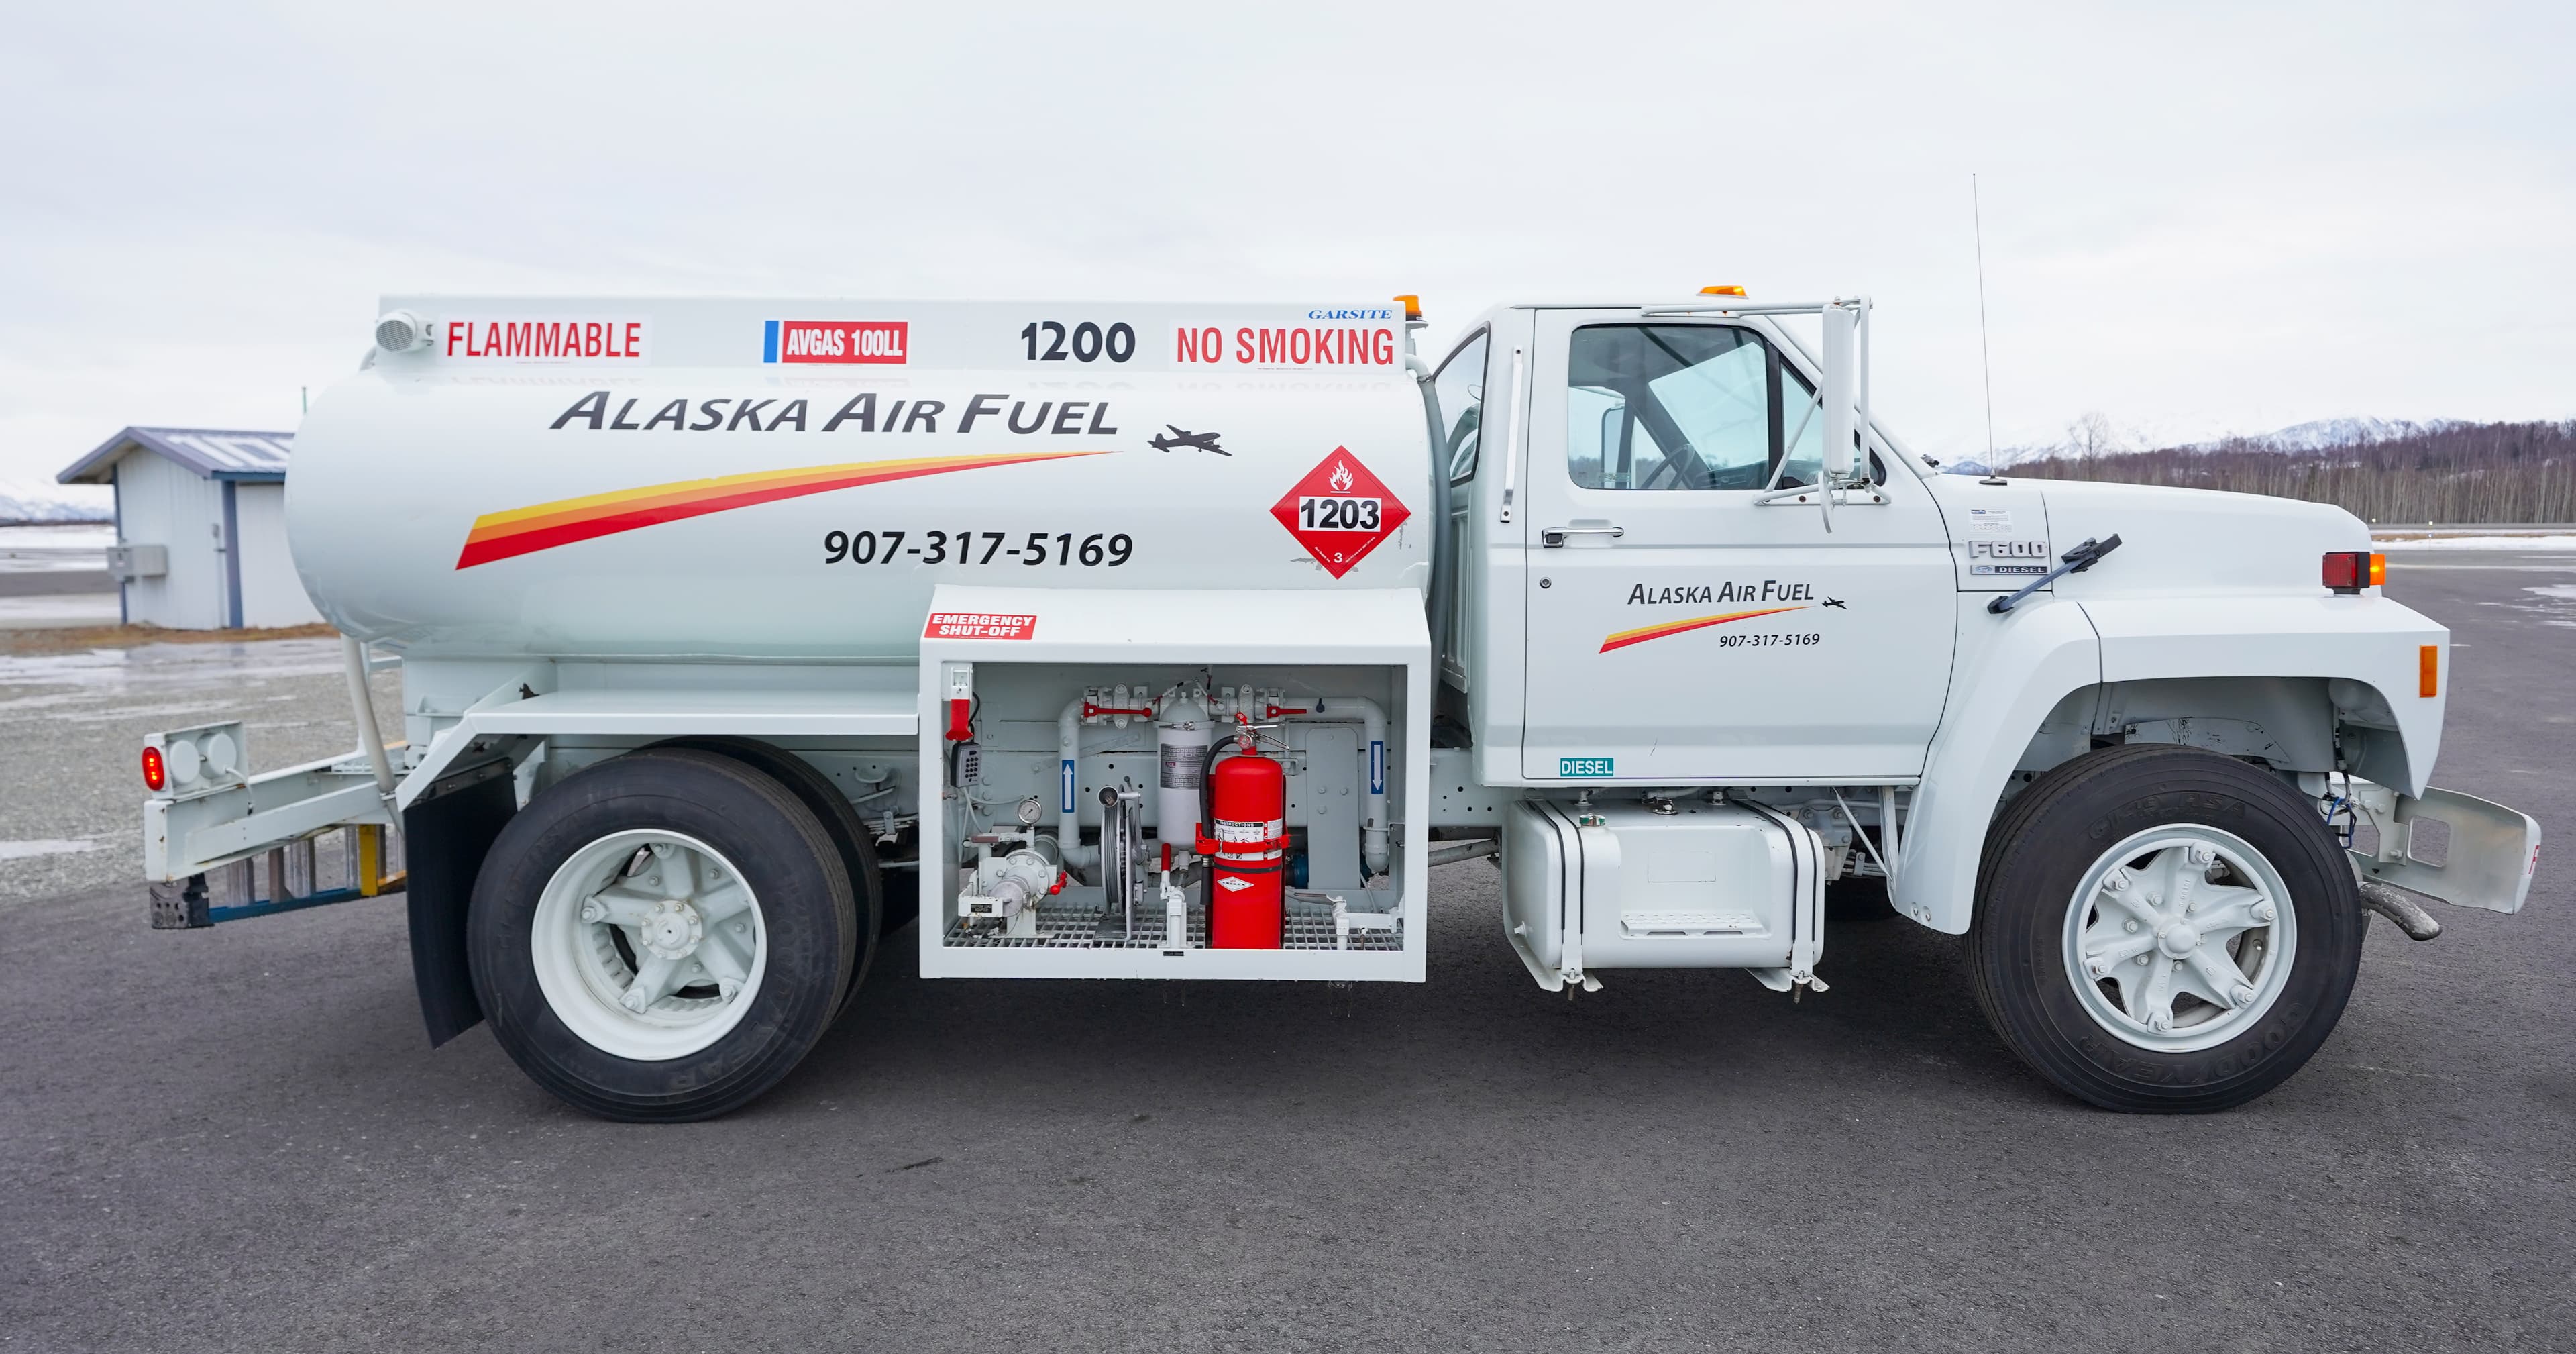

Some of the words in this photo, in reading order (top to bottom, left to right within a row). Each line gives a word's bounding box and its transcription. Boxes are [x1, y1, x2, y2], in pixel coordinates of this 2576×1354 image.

[1308, 309, 1393, 319] GARSITE
[447, 322, 641, 358] FLAMMABLE
[786, 329, 845, 356] AVGAS
[851, 329, 903, 356] 100LL
[1021, 321, 1136, 363] 1200
[1177, 327, 1222, 363] NO
[1236, 327, 1394, 365] SMOKING
[549, 391, 808, 432] ALASKA
[822, 393, 945, 434] AIR
[957, 393, 1118, 435] FUEL
[1300, 499, 1379, 530] 1203
[824, 530, 1134, 567] 907-317-5169
[1334, 552, 1343, 563] 3
[1968, 541, 2048, 558] F600
[1627, 582, 1712, 605] ALASKA
[1717, 581, 1756, 603] AIR
[1761, 580, 1814, 601] FUEL
[932, 615, 1034, 626] EMERGENCY
[938, 625, 1021, 637] SHUT-OFF
[1719, 633, 1821, 648] 907-317-5169
[1561, 760, 1613, 774] DIESEL
